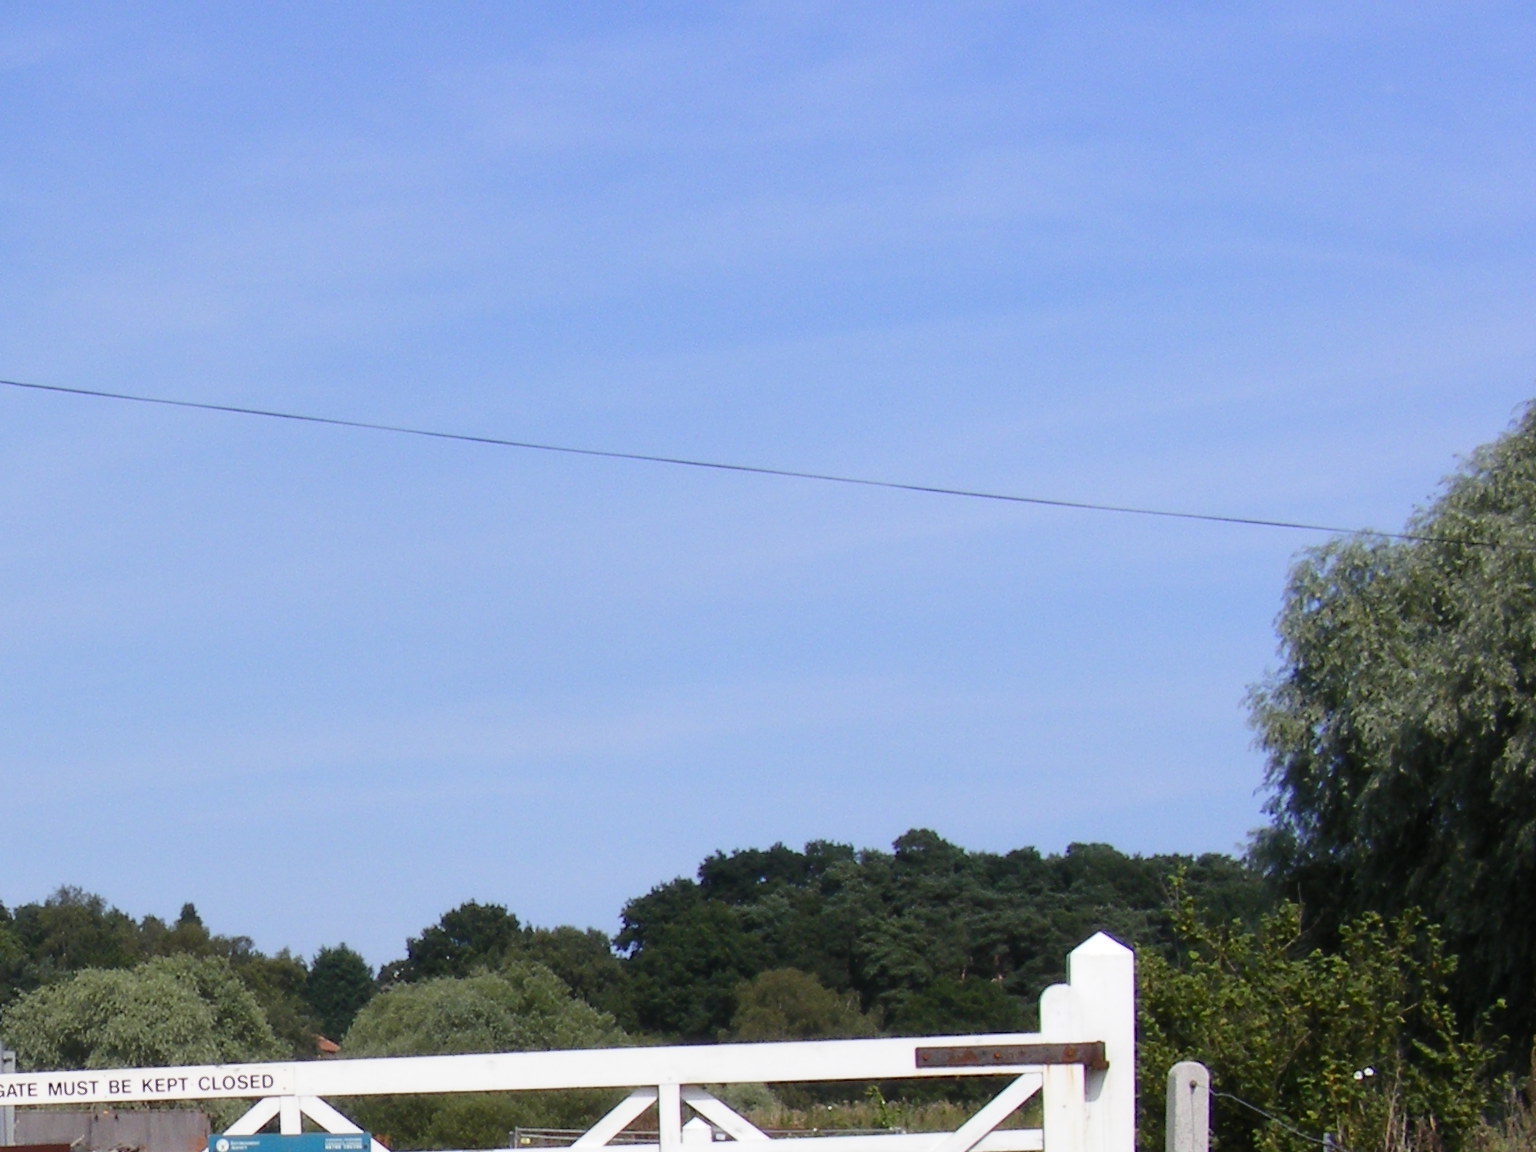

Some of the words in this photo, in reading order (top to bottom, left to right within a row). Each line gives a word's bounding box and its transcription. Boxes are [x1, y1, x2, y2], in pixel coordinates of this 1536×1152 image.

[48, 1080, 99, 1096] MUST
[109, 1079, 131, 1094] BE
[142, 1077, 188, 1093] KEPT
[198, 1074, 274, 1091] CLOSED
